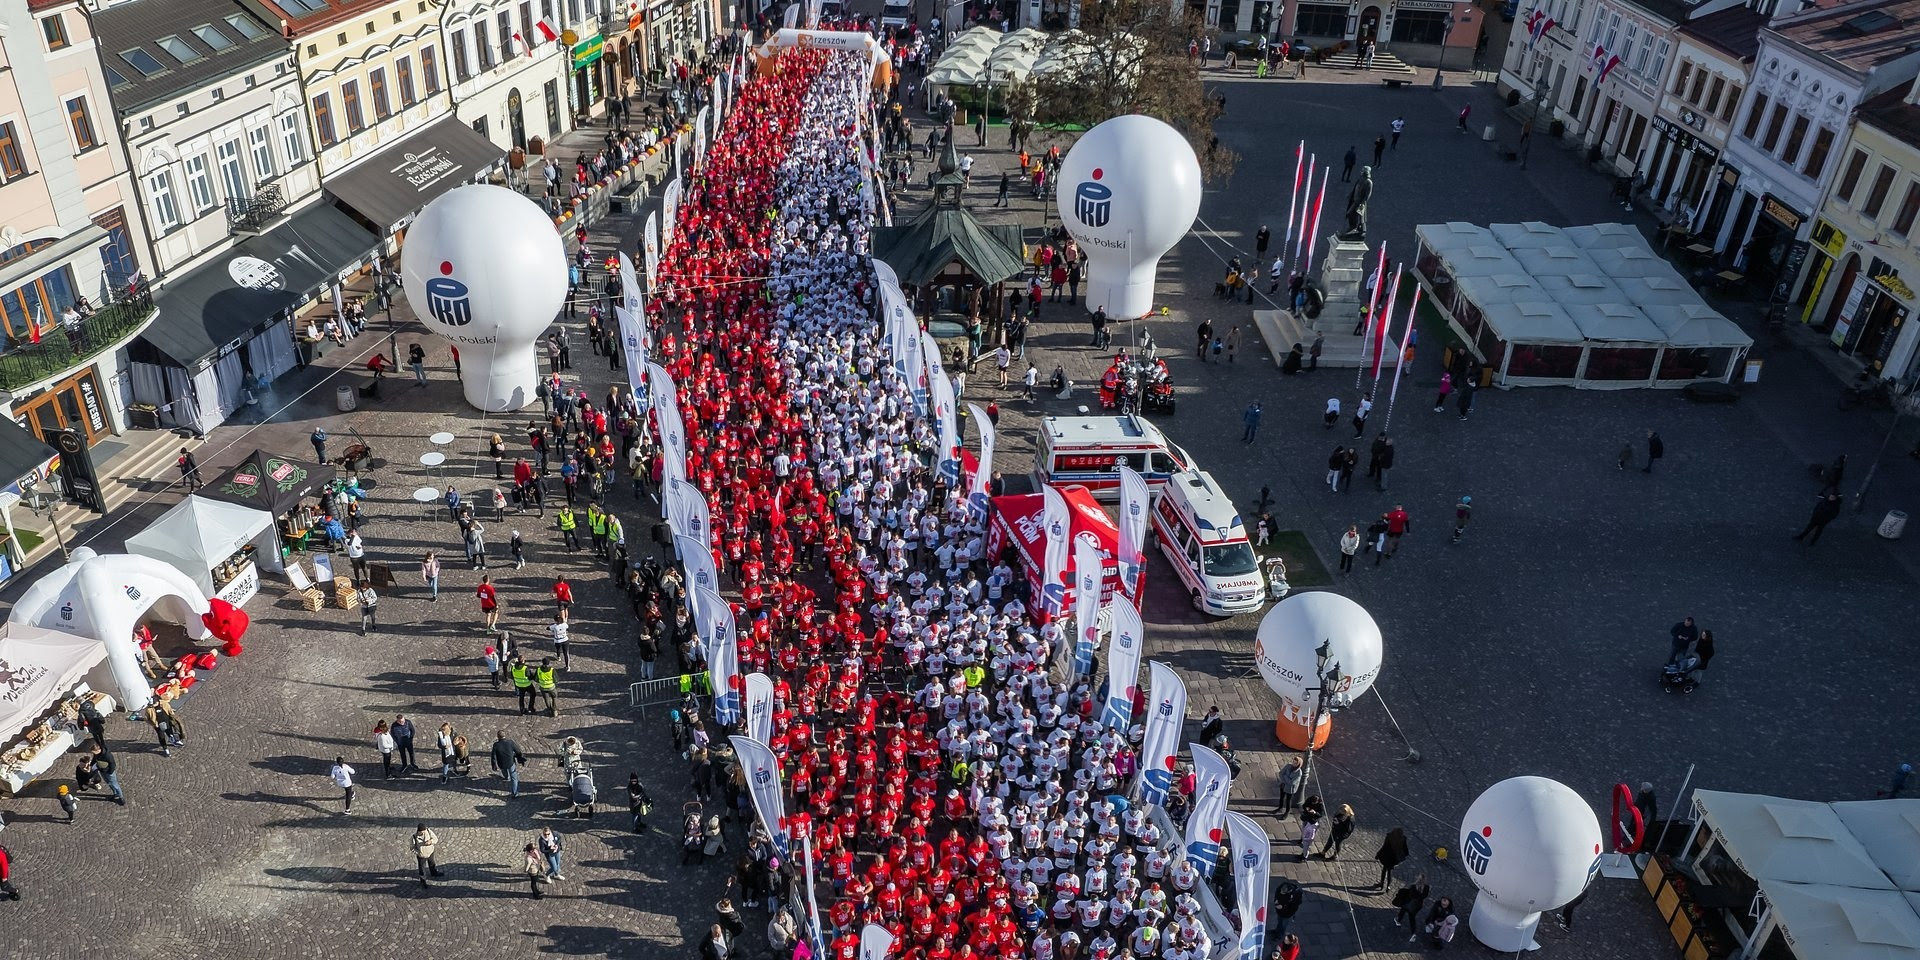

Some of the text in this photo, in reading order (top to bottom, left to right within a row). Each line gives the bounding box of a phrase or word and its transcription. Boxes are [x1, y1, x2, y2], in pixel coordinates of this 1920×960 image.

[814, 37, 847, 45] rzeszów
[406, 156, 454, 186] Rzeszowski
[1075, 182, 1112, 228] PKO
[1094, 237, 1126, 249] Polski
[426, 278, 472, 326] PKO
[458, 336, 497, 344] Polski
[1014, 515, 1040, 544] PCRM
[1264, 656, 1303, 682] rzeszów
[1464, 831, 1492, 876] PKO
